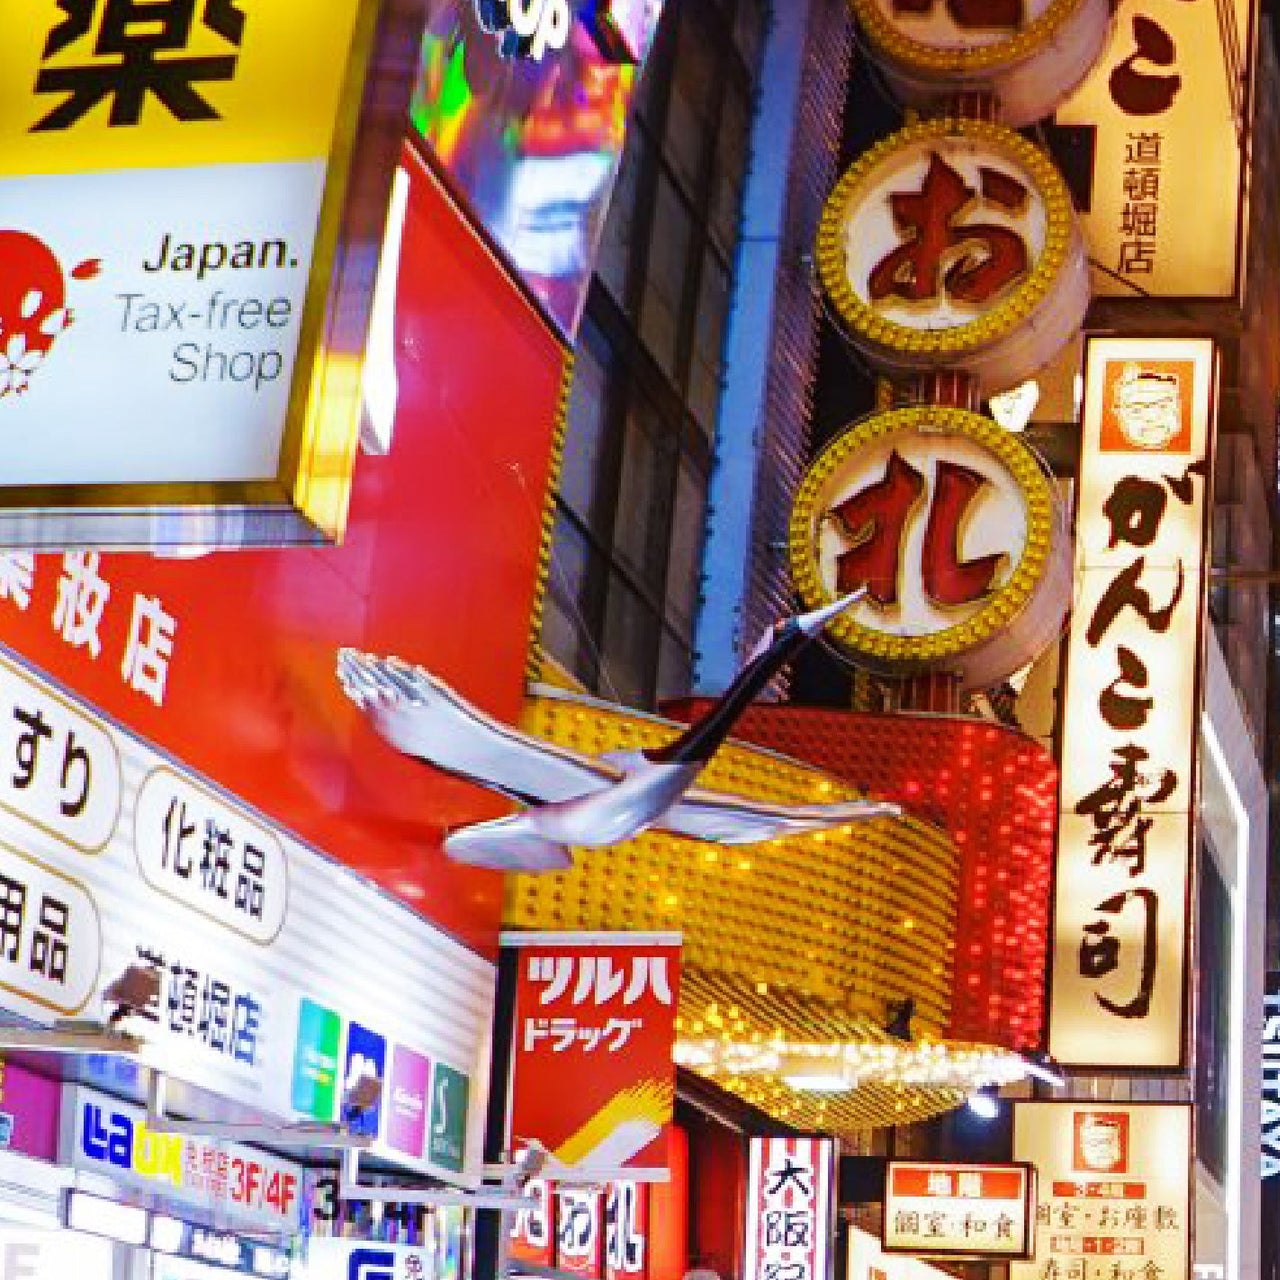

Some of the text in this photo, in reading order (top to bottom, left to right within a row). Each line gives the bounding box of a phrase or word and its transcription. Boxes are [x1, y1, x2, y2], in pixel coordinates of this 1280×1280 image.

[1117, 131, 1165, 276] 道頓堀店
[142, 232, 300, 284] Japan.
[115, 289, 293, 331] Tax-free
[168, 342, 284, 391] Shop
[162, 798, 266, 922] 化粧品
[527, 956, 673, 1006] ツルハ
[523, 1017, 642, 1053] ドラッグ
